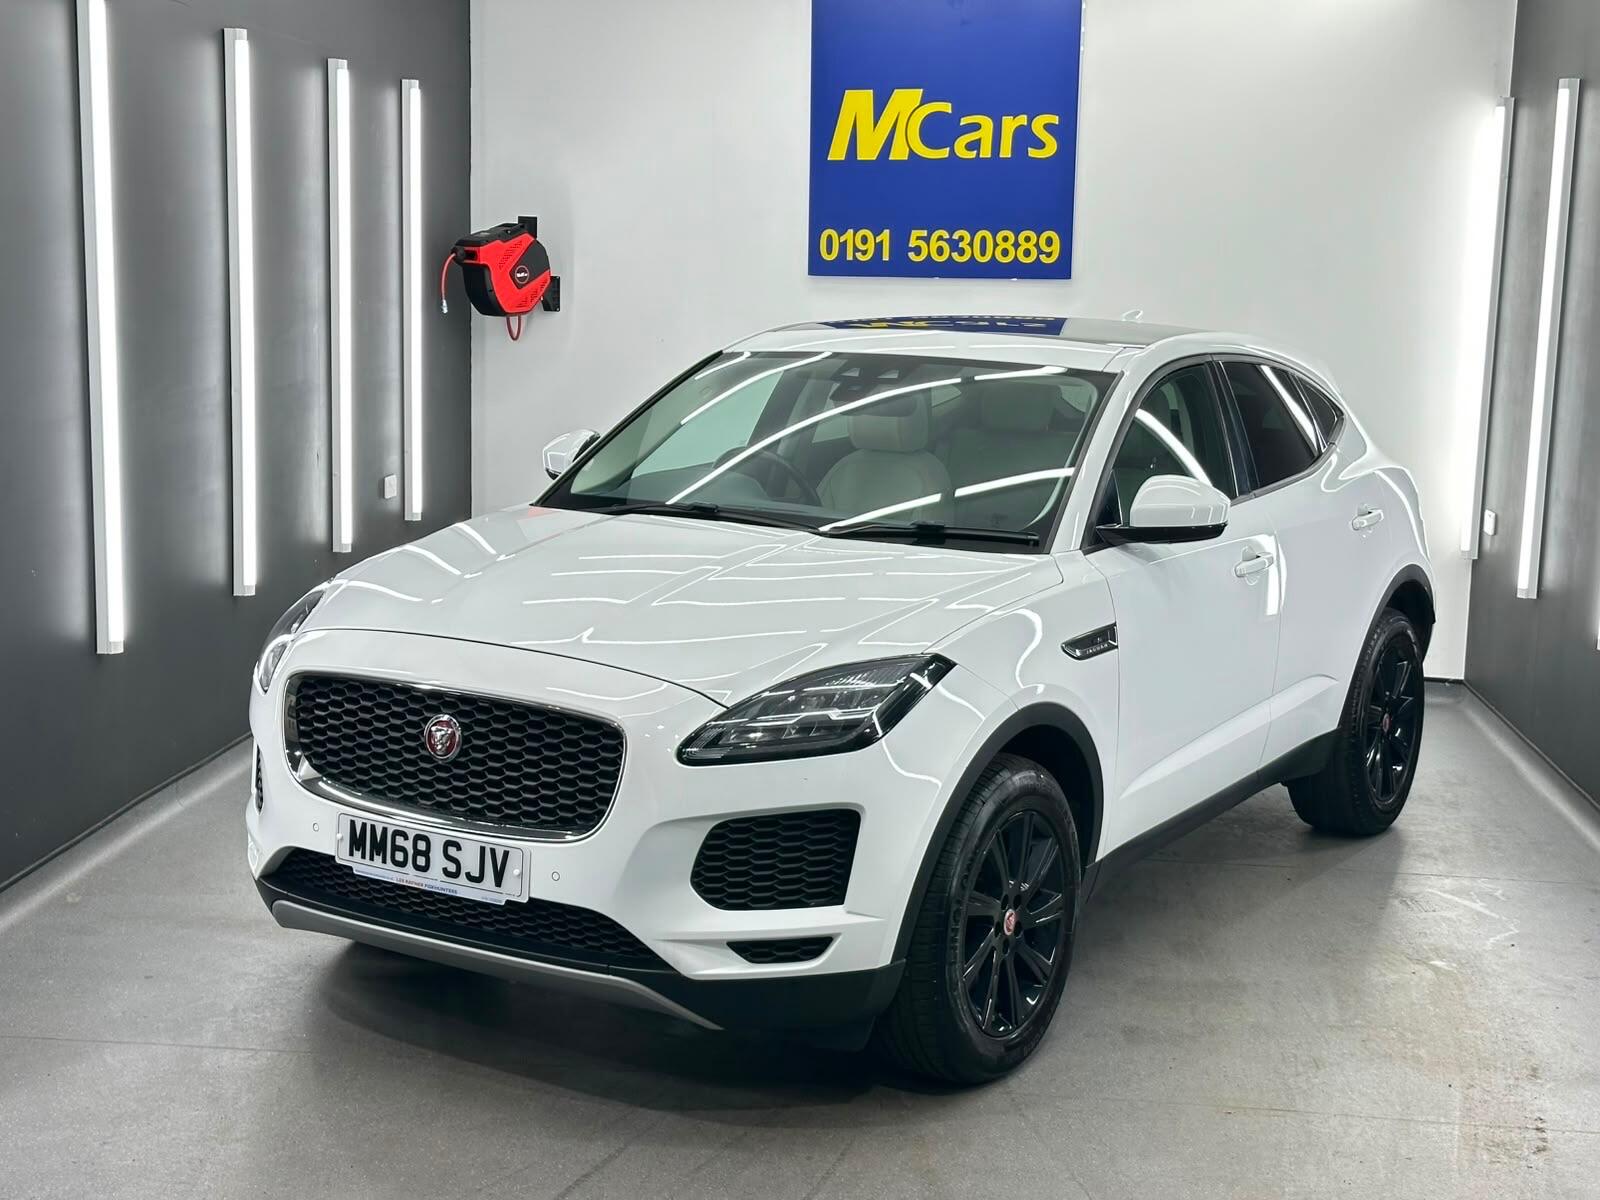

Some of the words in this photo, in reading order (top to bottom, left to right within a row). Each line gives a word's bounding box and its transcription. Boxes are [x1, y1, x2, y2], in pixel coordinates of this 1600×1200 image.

[827, 88, 1059, 160] MCars
[819, 228, 890, 261] 0191
[907, 229, 1061, 263] 5630889
[348, 819, 431, 873] MM68
[442, 839, 510, 888] SJV
